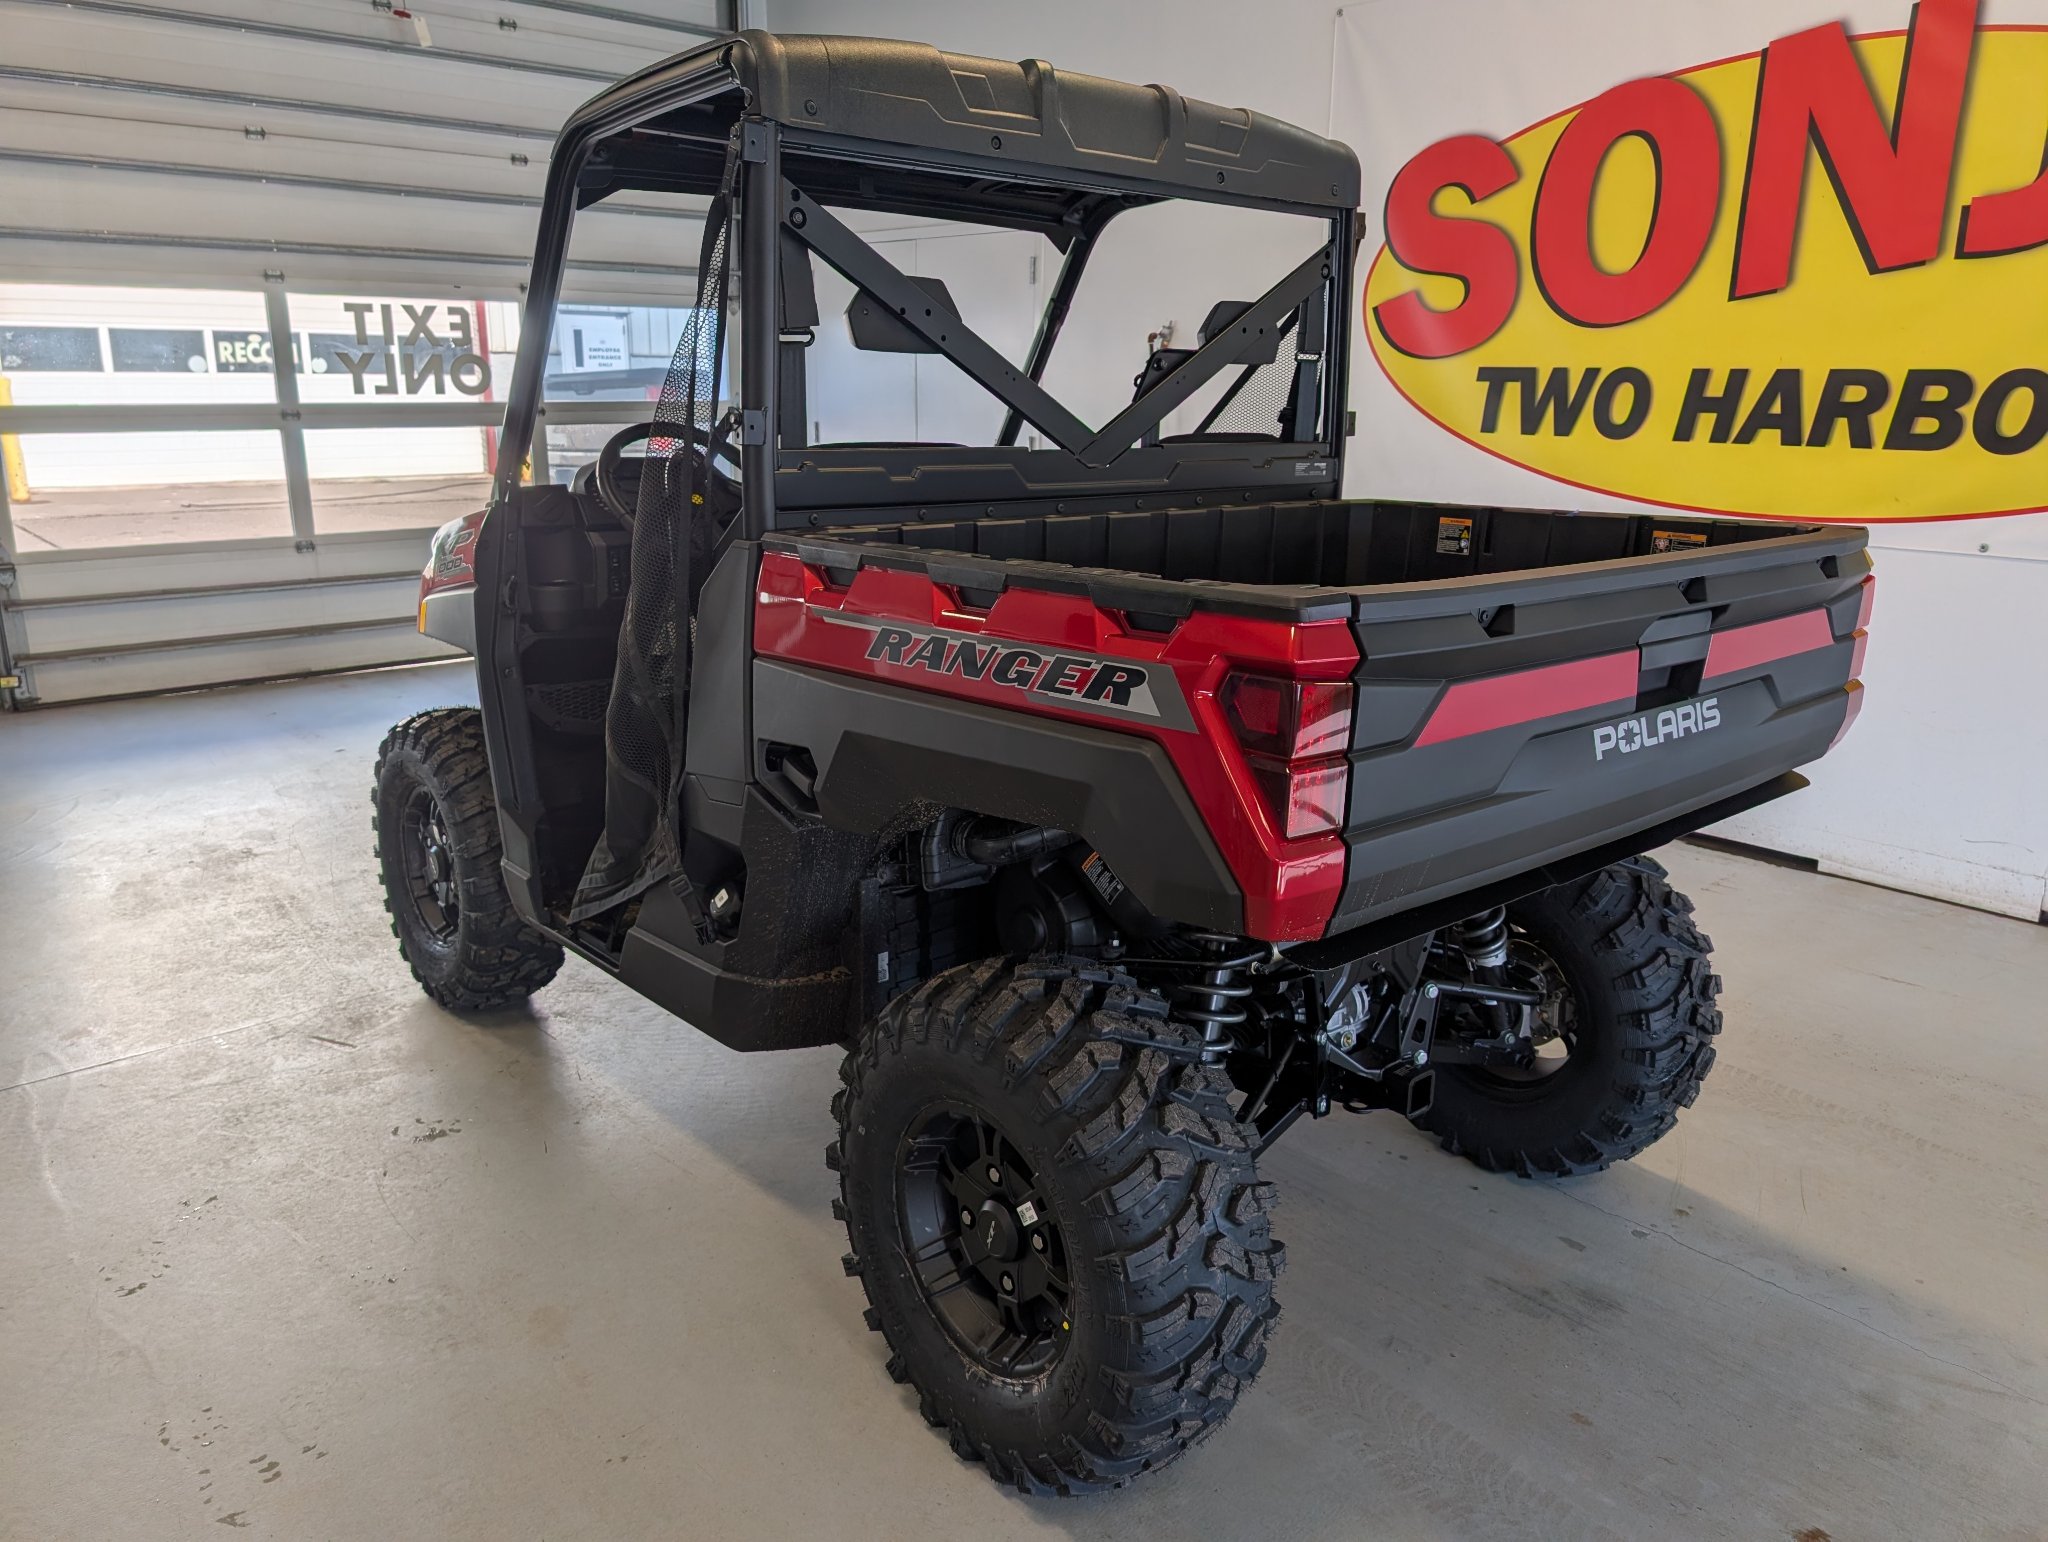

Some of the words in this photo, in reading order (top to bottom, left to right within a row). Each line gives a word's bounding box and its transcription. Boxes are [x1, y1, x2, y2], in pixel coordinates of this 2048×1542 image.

[1476, 366, 1652, 440] TWO
[865, 626, 1149, 707] RANGER
[1593, 697, 1721, 761] POLARIS
